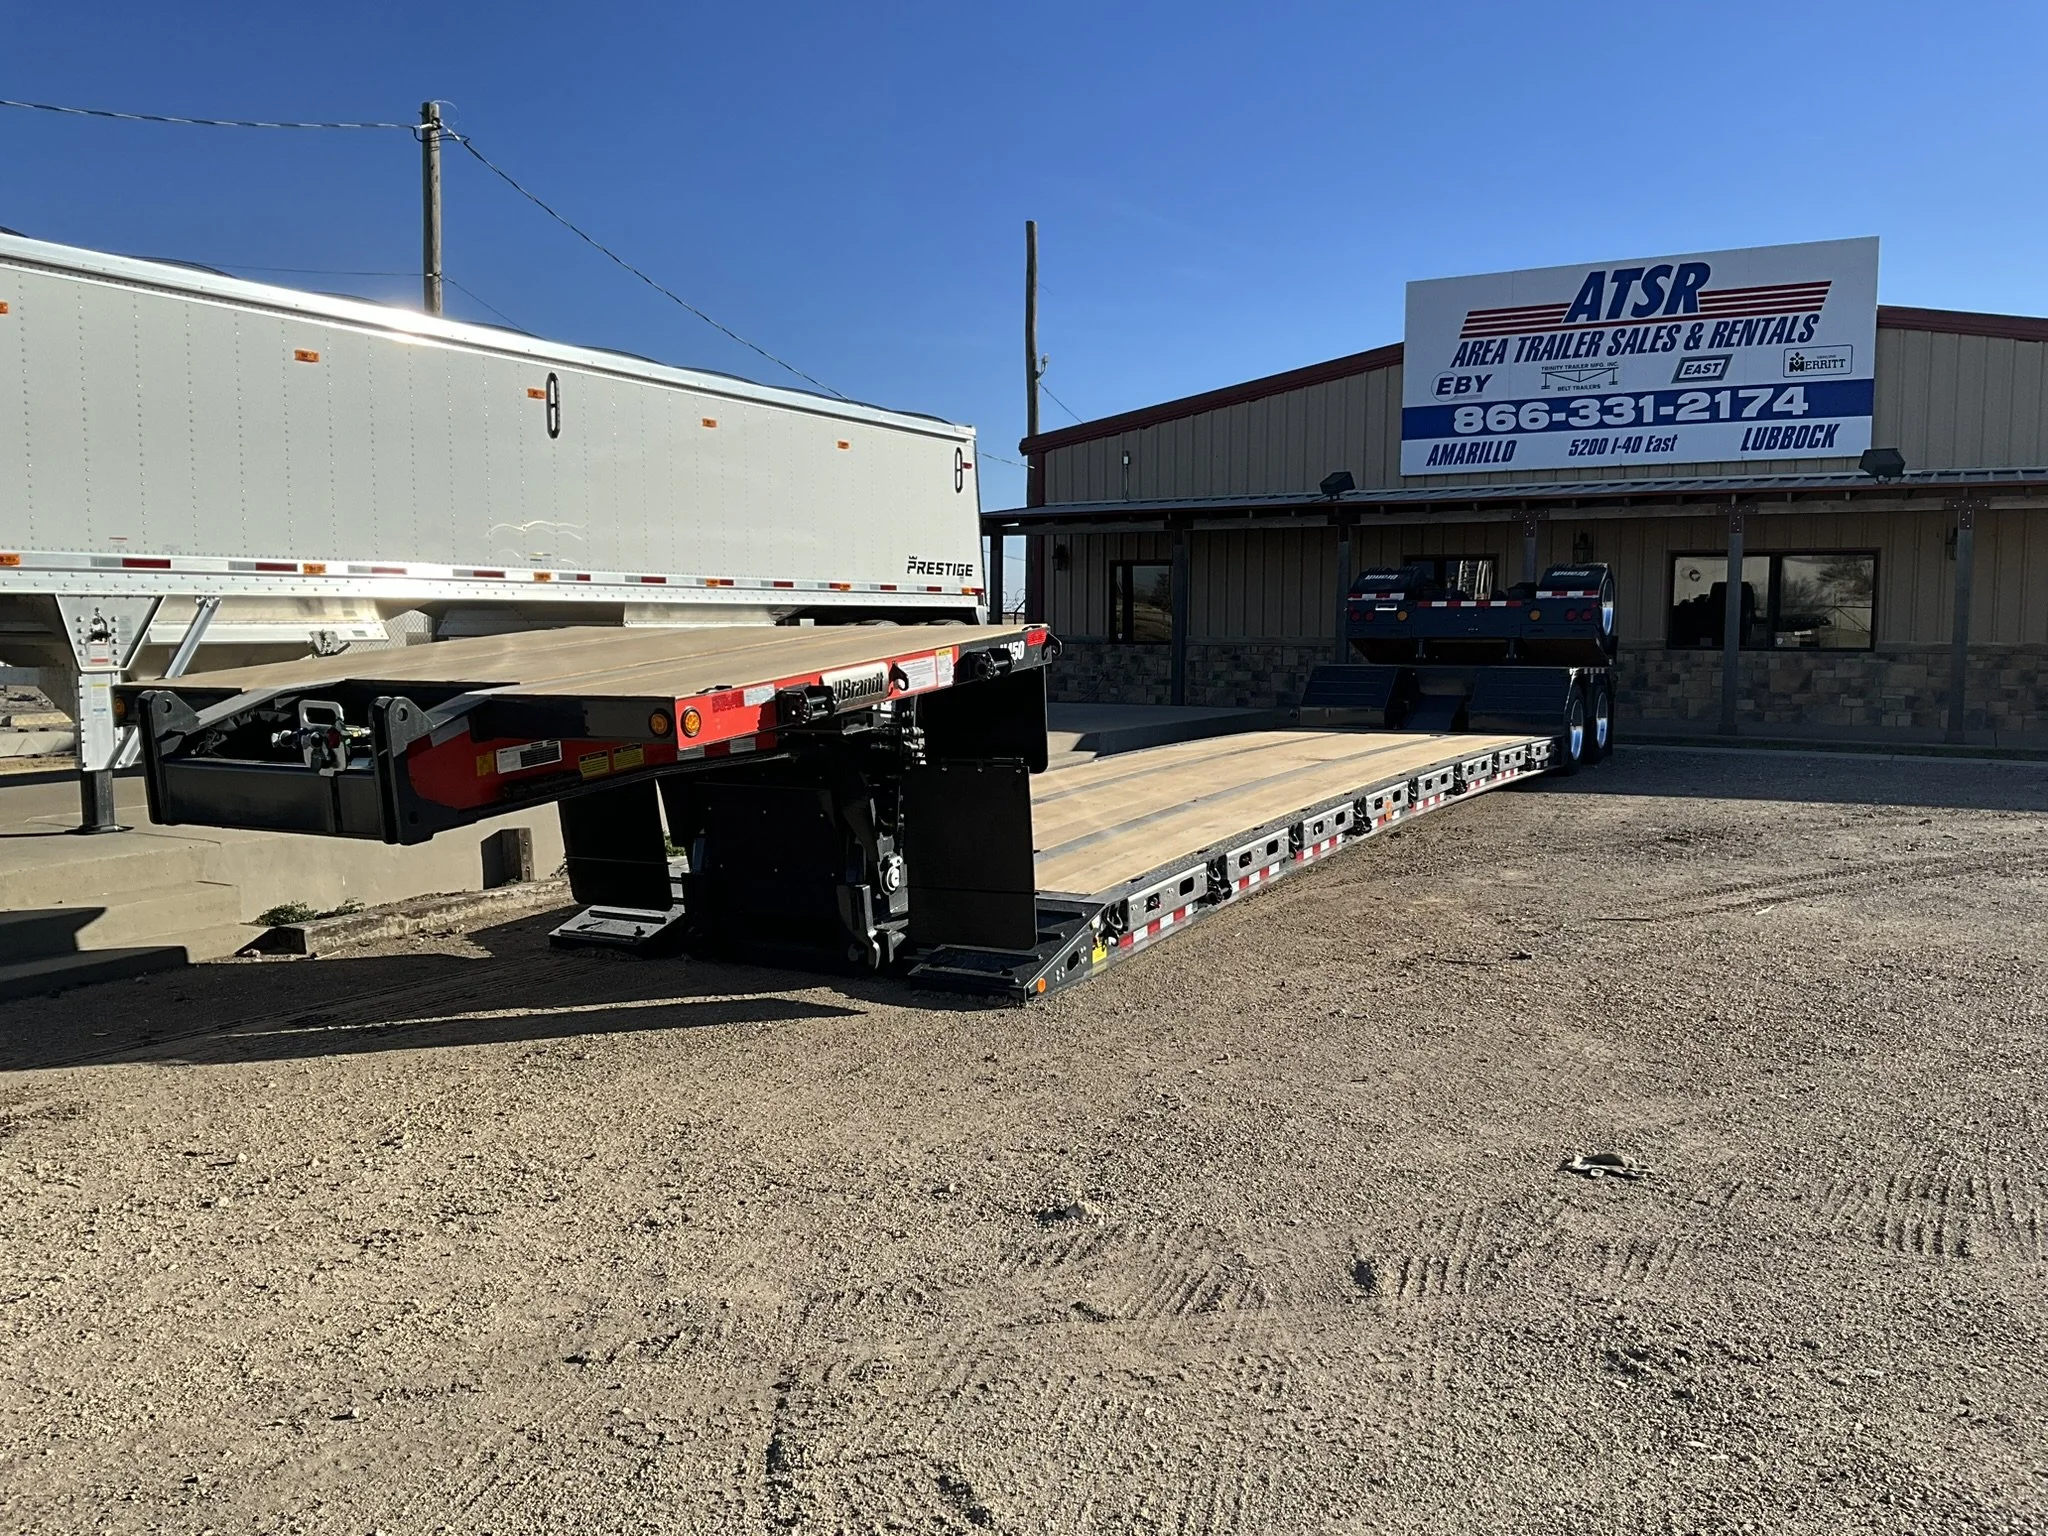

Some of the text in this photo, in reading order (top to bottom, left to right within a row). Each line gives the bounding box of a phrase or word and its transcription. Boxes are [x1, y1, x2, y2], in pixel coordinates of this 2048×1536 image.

[1562, 261, 1710, 323] ATSR
[1450, 313, 1821, 368] AREA TRAILER SALES & RENTALS
[1683, 361, 1722, 376] EAST
[1788, 358, 1846, 372] MERRITT
[1435, 374, 1493, 396] EBY
[1572, 383, 1601, 391] TRAILERS
[1453, 385, 1809, 434] 866-331-2174
[1568, 434, 1678, 457] 5200 I-40 East
[1740, 423, 1840, 452] LUBBOCK
[1425, 440, 1518, 467] AMARILLO
[906, 560, 973, 577] PRESTIGE
[843, 672, 884, 700] Brandt
